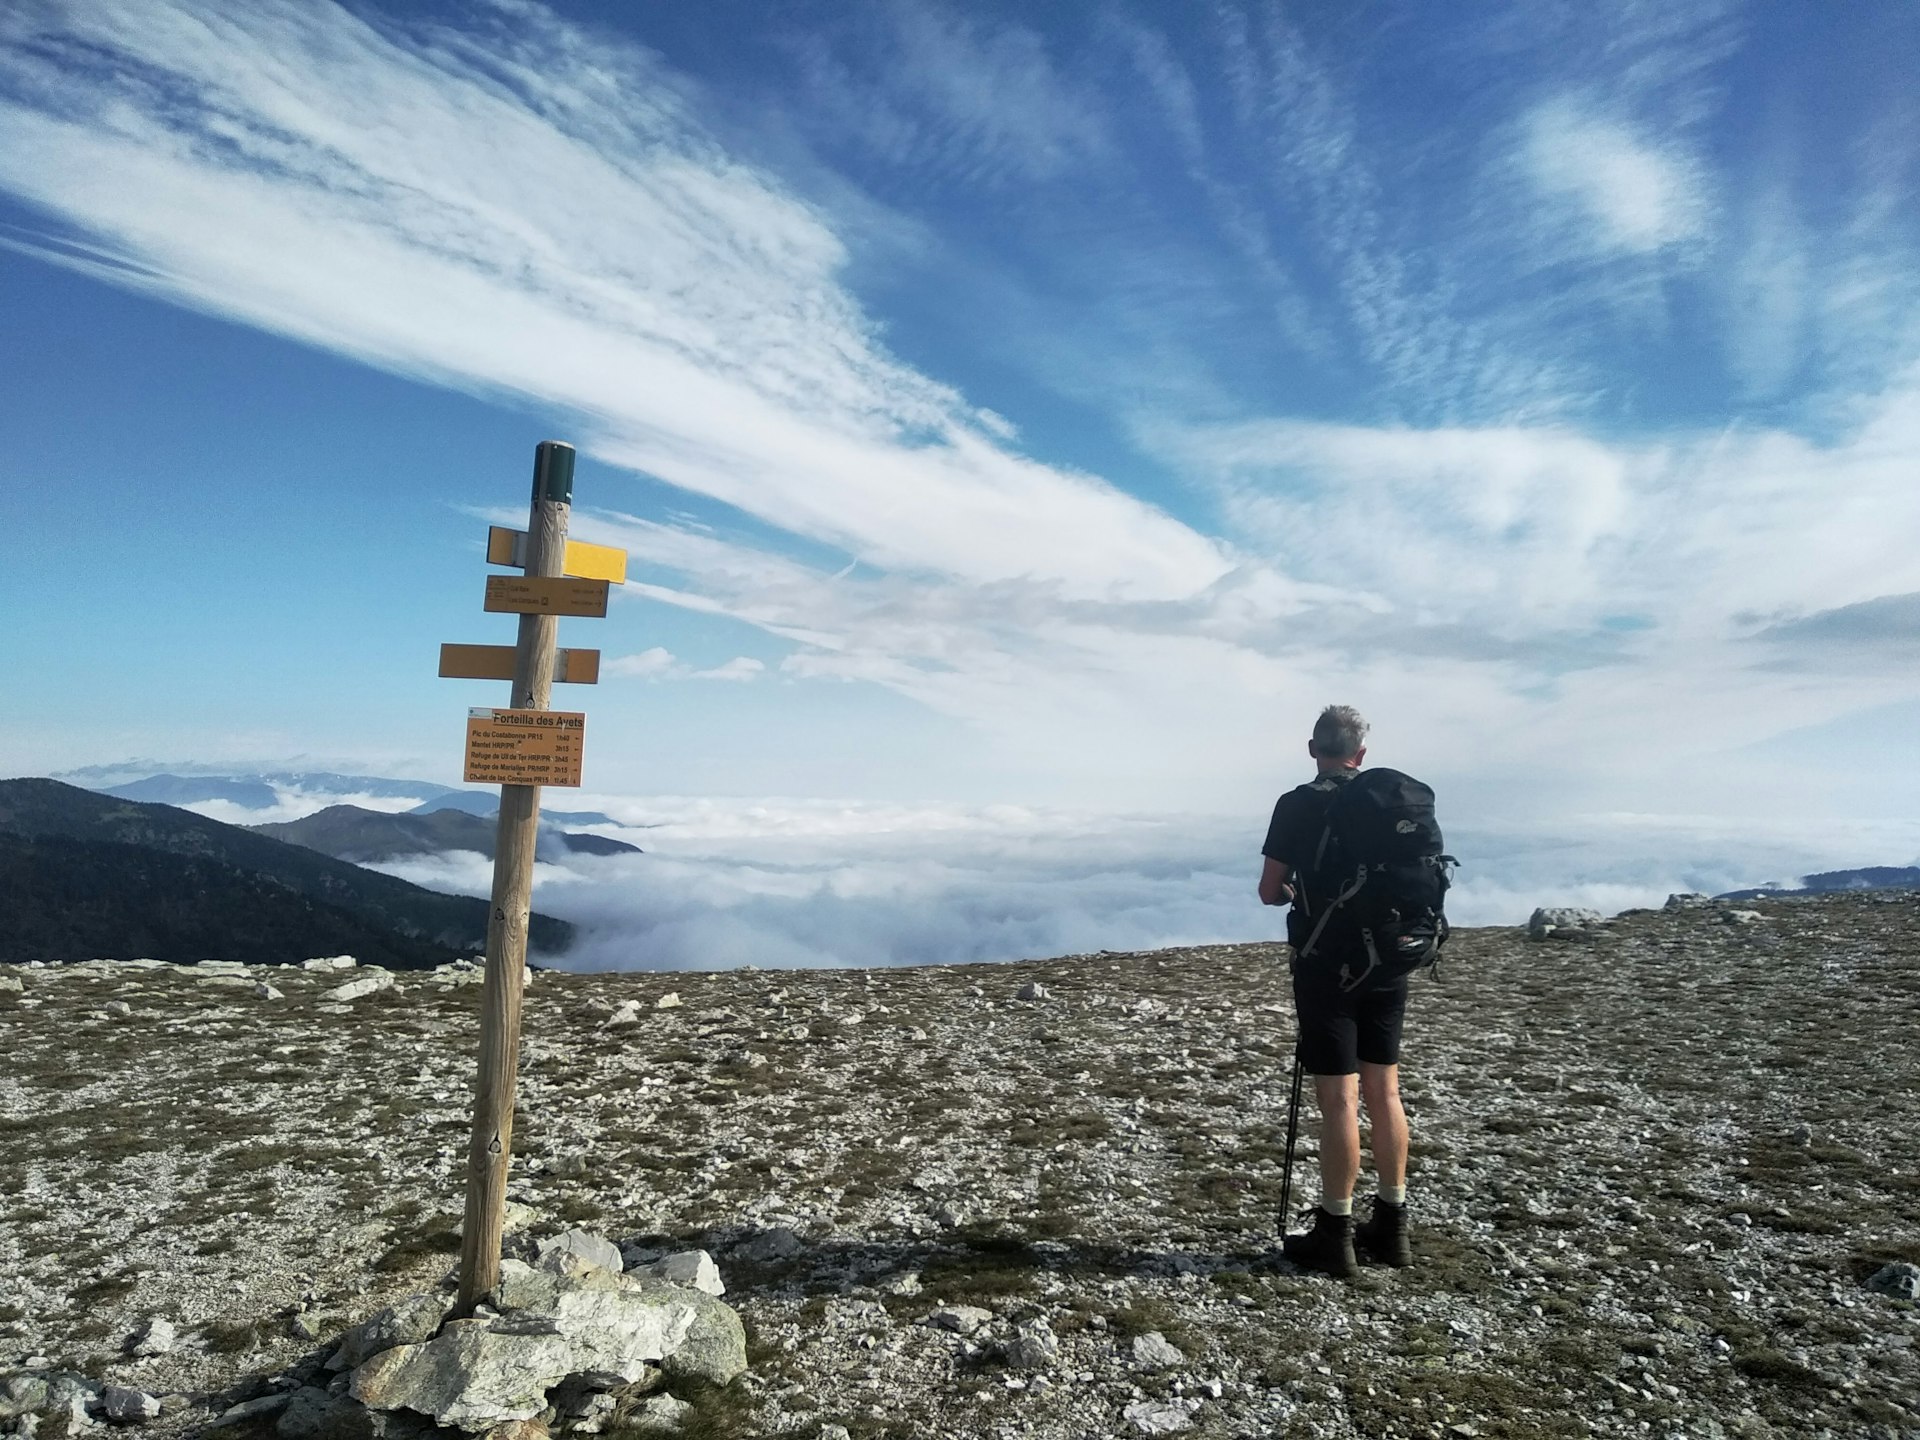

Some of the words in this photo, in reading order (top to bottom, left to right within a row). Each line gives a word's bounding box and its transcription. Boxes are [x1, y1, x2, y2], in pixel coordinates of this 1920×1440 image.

[493, 713, 533, 724] Forteilla
[536, 715, 553, 725] des
[556, 716, 583, 727] Avets
[492, 731, 526, 739] Costabonne
[527, 732, 543, 740] PR15
[471, 751, 491, 760] Refuge
[470, 761, 490, 770] Refuge
